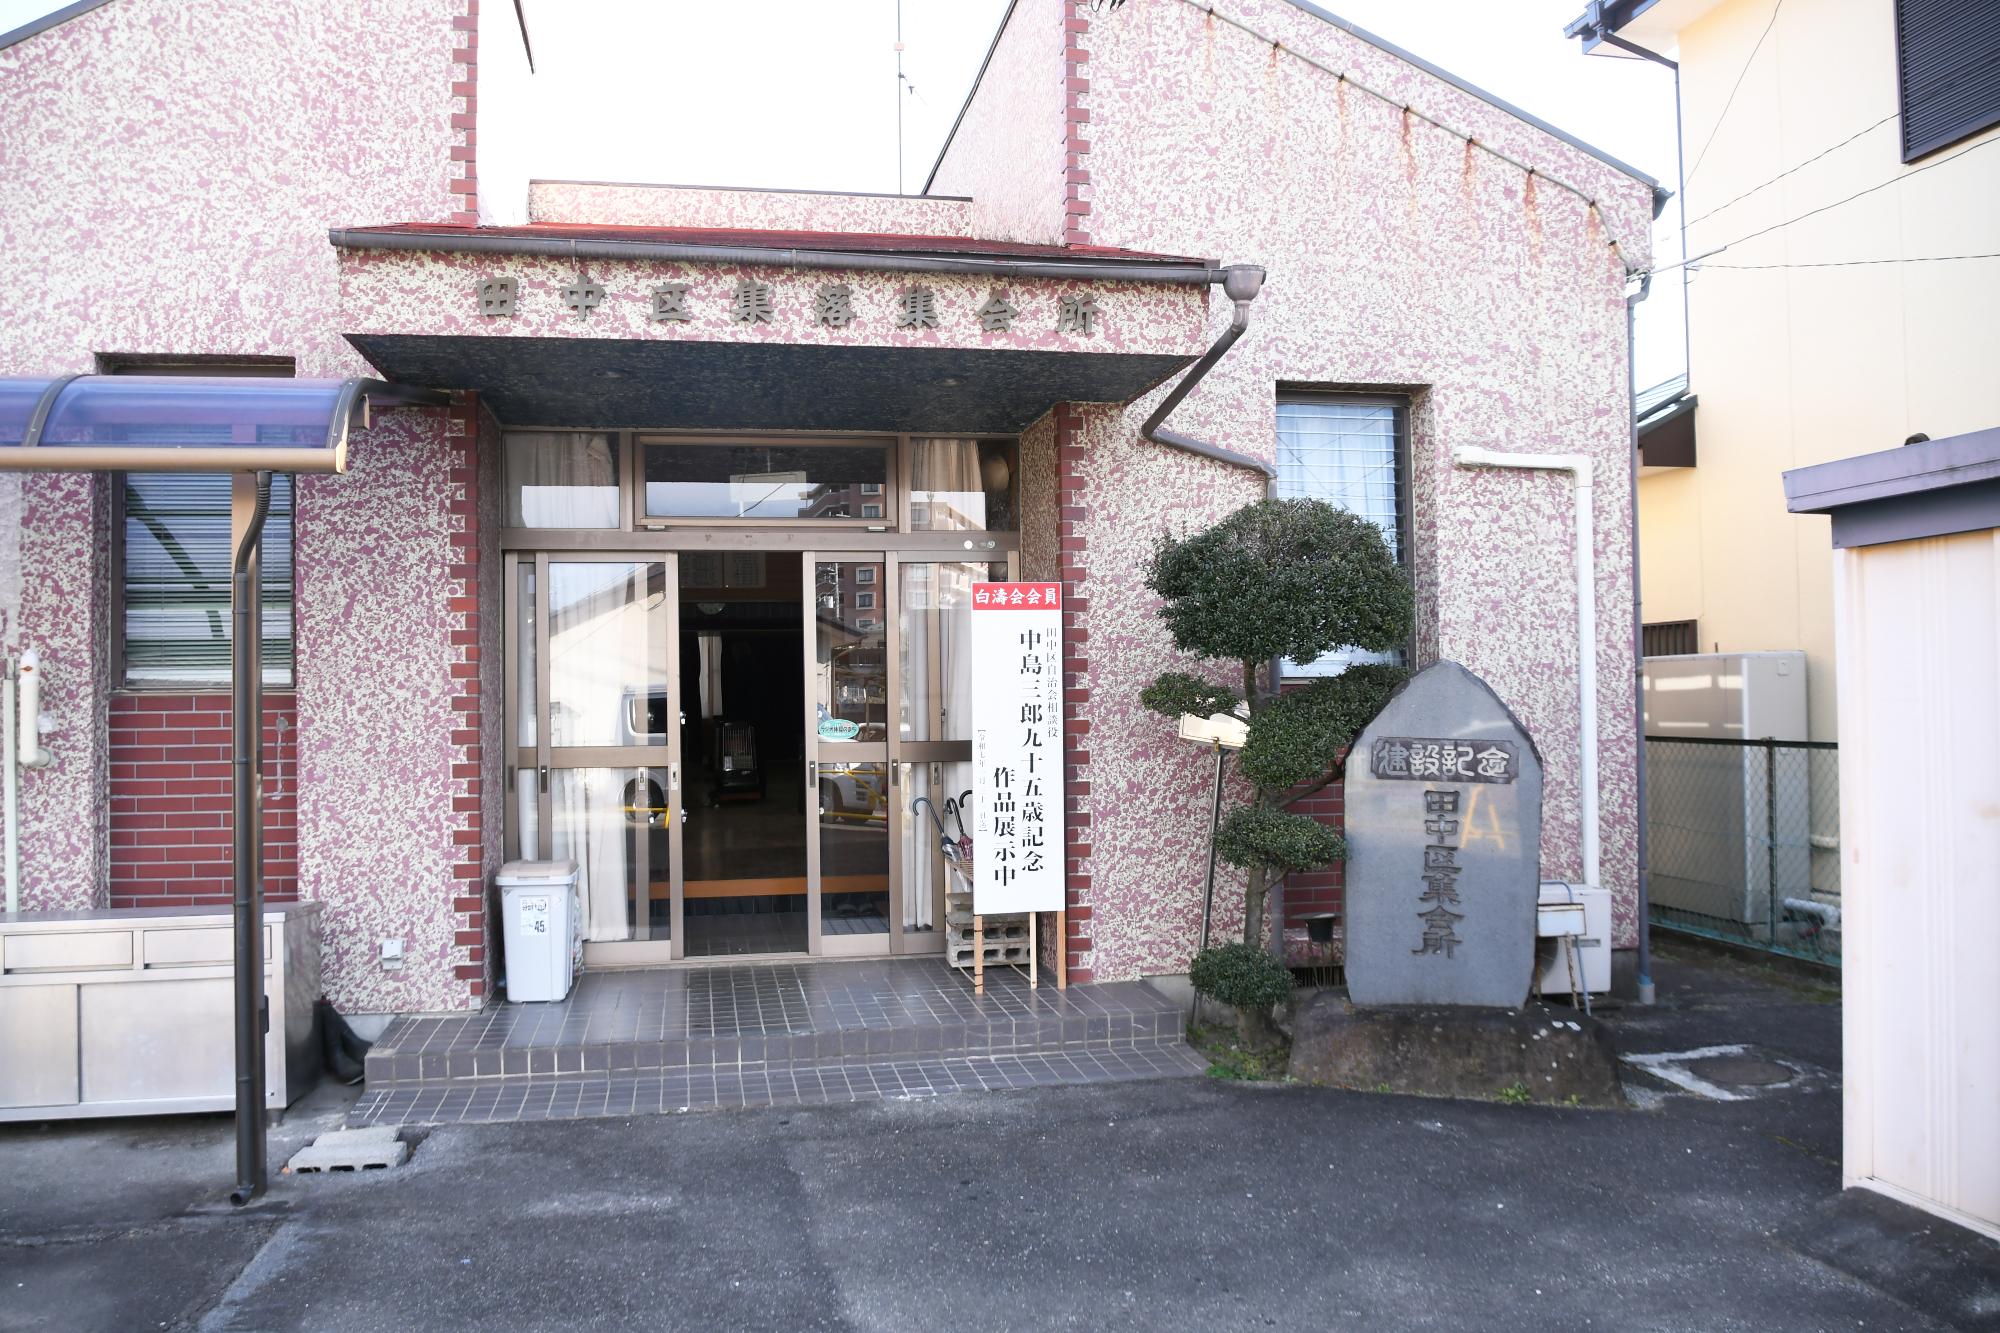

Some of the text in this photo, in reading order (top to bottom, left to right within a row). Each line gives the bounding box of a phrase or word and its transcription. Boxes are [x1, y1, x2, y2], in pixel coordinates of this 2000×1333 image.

[476, 274, 1105, 335] 田中区集落集会所
[975, 587, 1057, 605] 白濤会会員
[1046, 627, 1059, 738] 田中区自治会相談役
[1020, 629, 1044, 872] 中島三郎九十五歳記念
[1378, 741, 1511, 779] 建設記念
[994, 766, 1017, 887] 作品展示中
[1411, 790, 1465, 960] 田中区集会所
